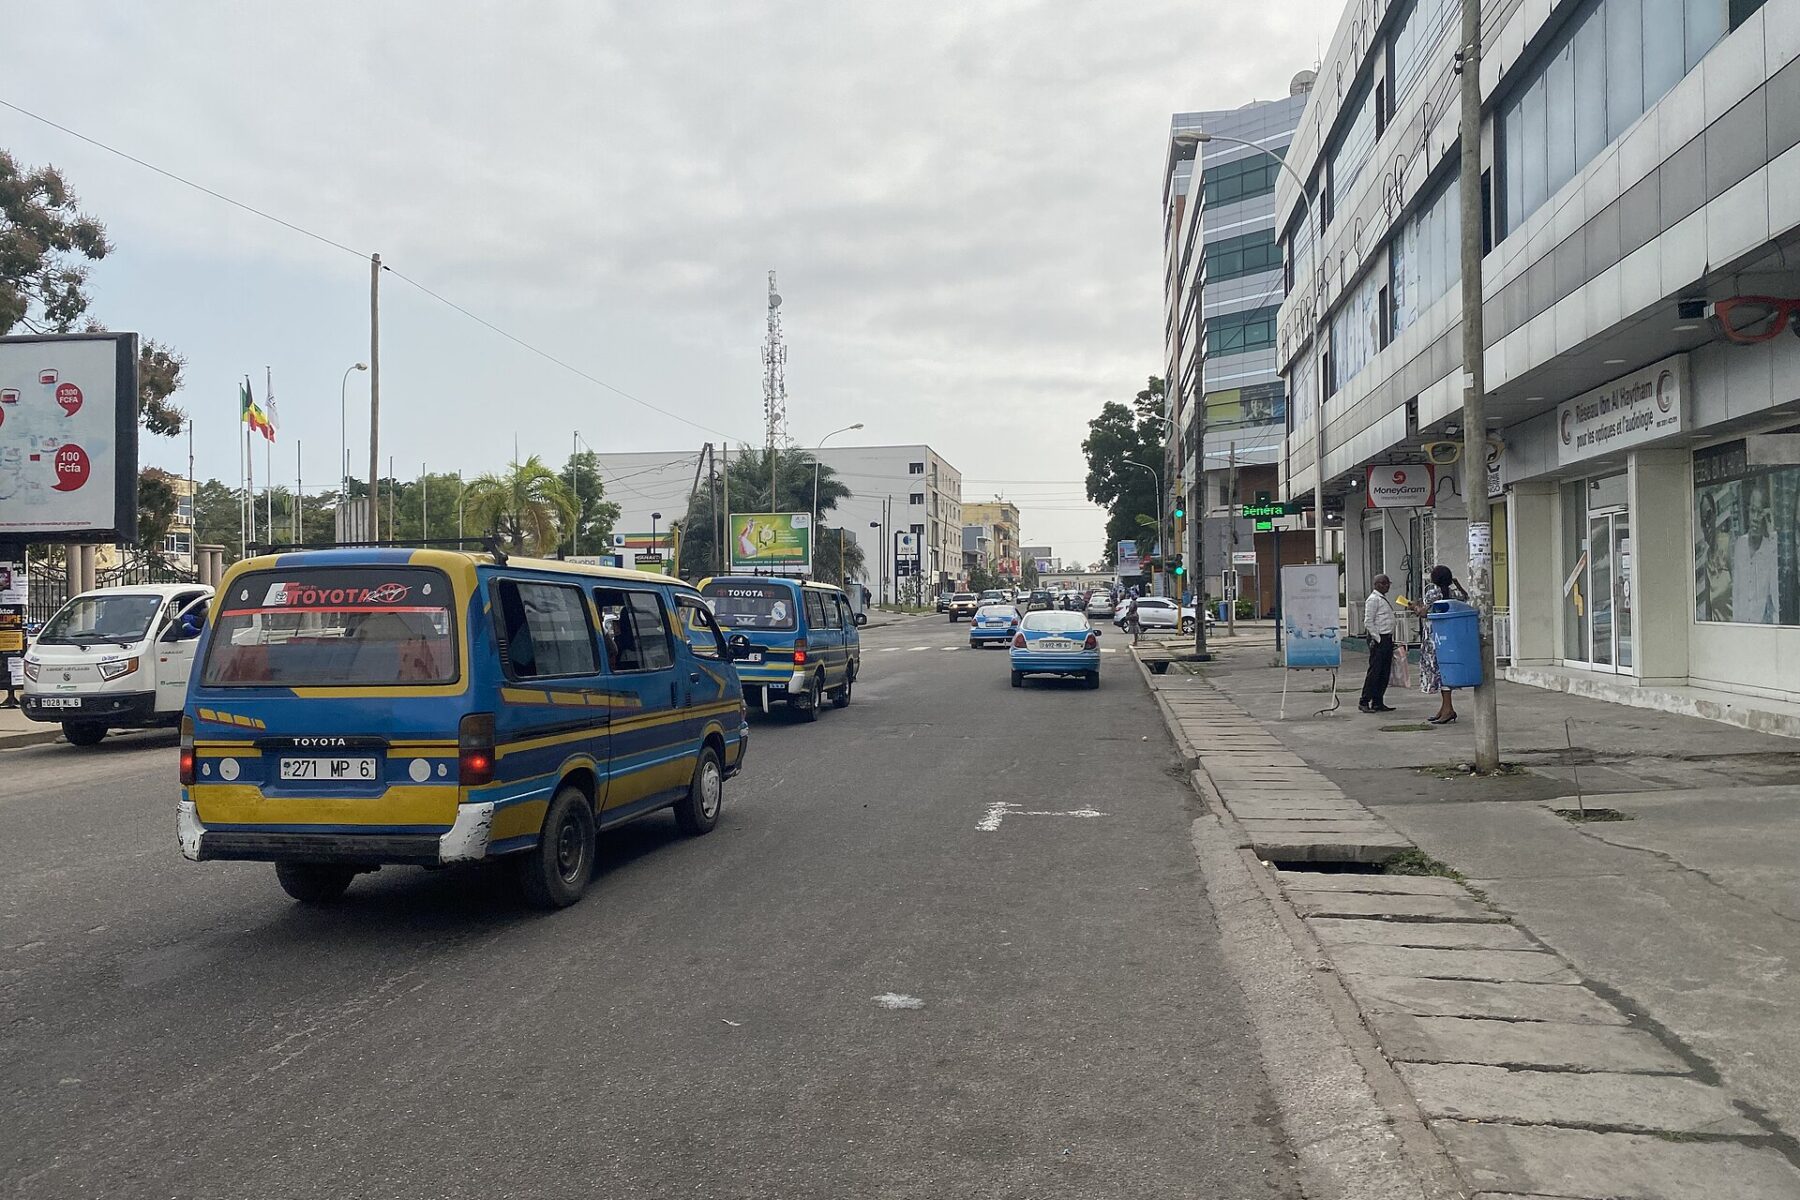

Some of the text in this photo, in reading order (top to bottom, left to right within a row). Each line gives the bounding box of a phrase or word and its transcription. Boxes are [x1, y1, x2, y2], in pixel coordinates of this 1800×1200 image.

[59, 396, 78, 404] FCFA
[1611, 388, 1620, 411] Al
[1620, 381, 1653, 410] Haytham
[1576, 433, 1587, 452] pour
[1587, 428, 1595, 445] les
[1595, 423, 1616, 446] optiques
[1616, 419, 1622, 436] et
[60, 451, 80, 462] 100
[58, 463, 81, 473] Fcfa
[1373, 486, 1426, 495] MoneyGram
[287, 589, 369, 605] TOYOTA
[728, 589, 764, 597] TOYOTA
[46, 698, 61, 707] 028
[74, 698, 79, 706] 6
[293, 738, 346, 746] TOYOTA
[292, 760, 370, 777] 271 MP 6
